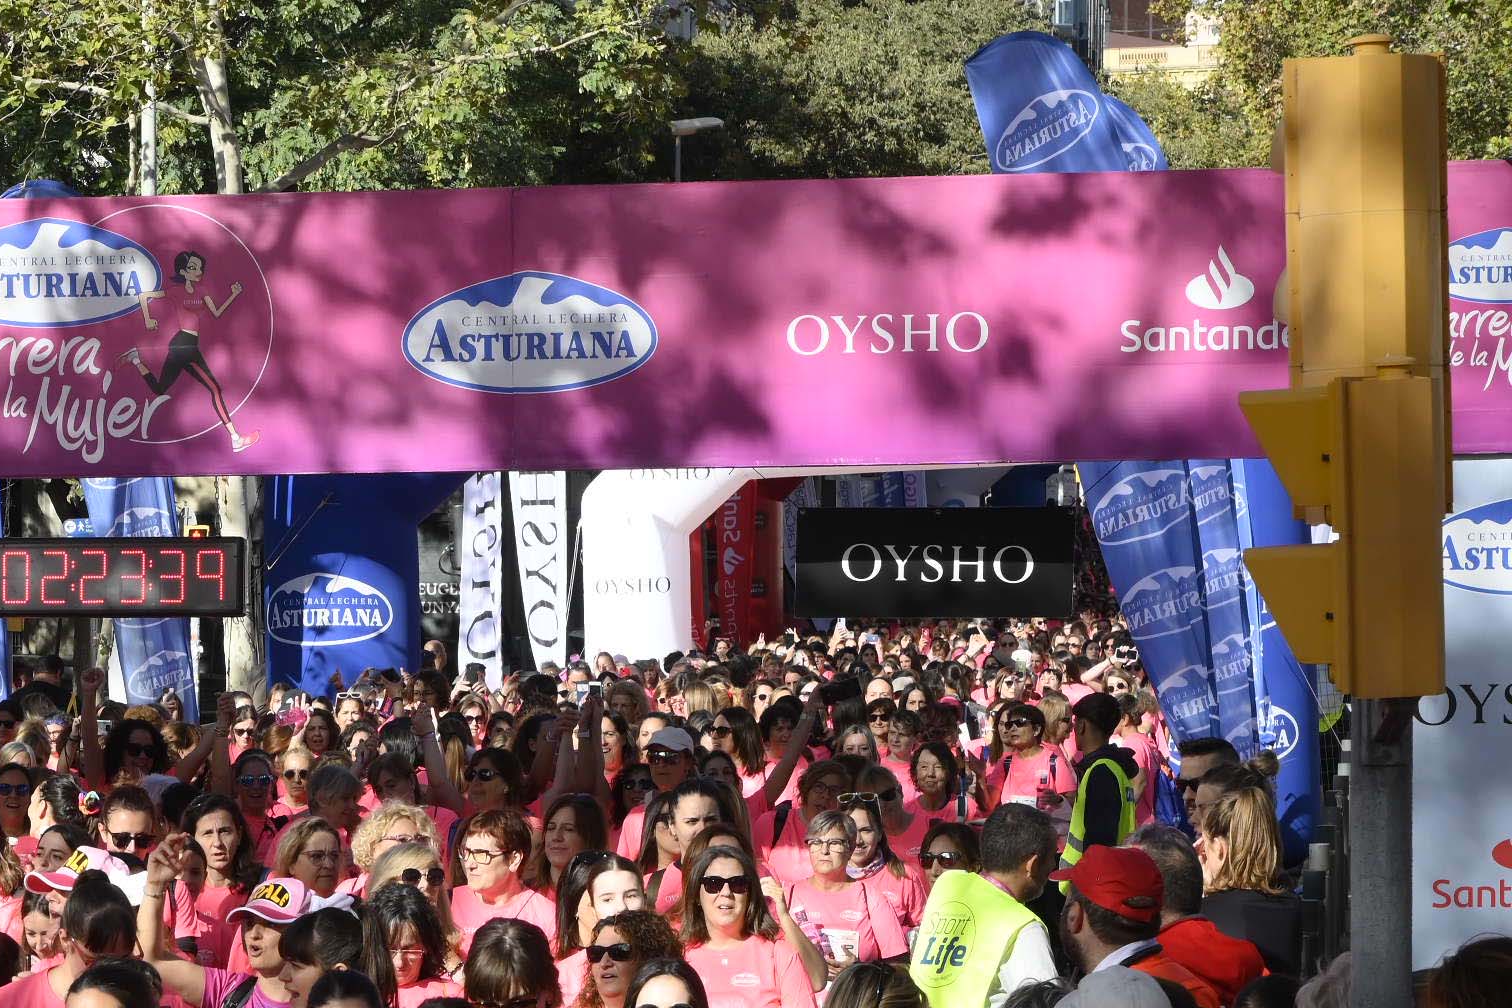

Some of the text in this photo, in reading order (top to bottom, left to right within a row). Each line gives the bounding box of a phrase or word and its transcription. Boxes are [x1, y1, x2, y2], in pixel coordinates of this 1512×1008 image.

[63, 254, 137, 266] LECHERA
[461, 312, 628, 327] CENTRAL LECHERA
[786, 311, 989, 355] OYSHO
[422, 318, 637, 363] ASTURIANA
[3, 378, 27, 418] la
[23, 369, 172, 464] Mujer
[1, 550, 225, 605] 02:23:39
[841, 543, 1035, 584] OYSHO
[270, 600, 384, 630] ASTURIANA
[330, 596, 379, 606] LECHERA
[925, 912, 972, 934] Sport
[920, 935, 968, 974] Life
